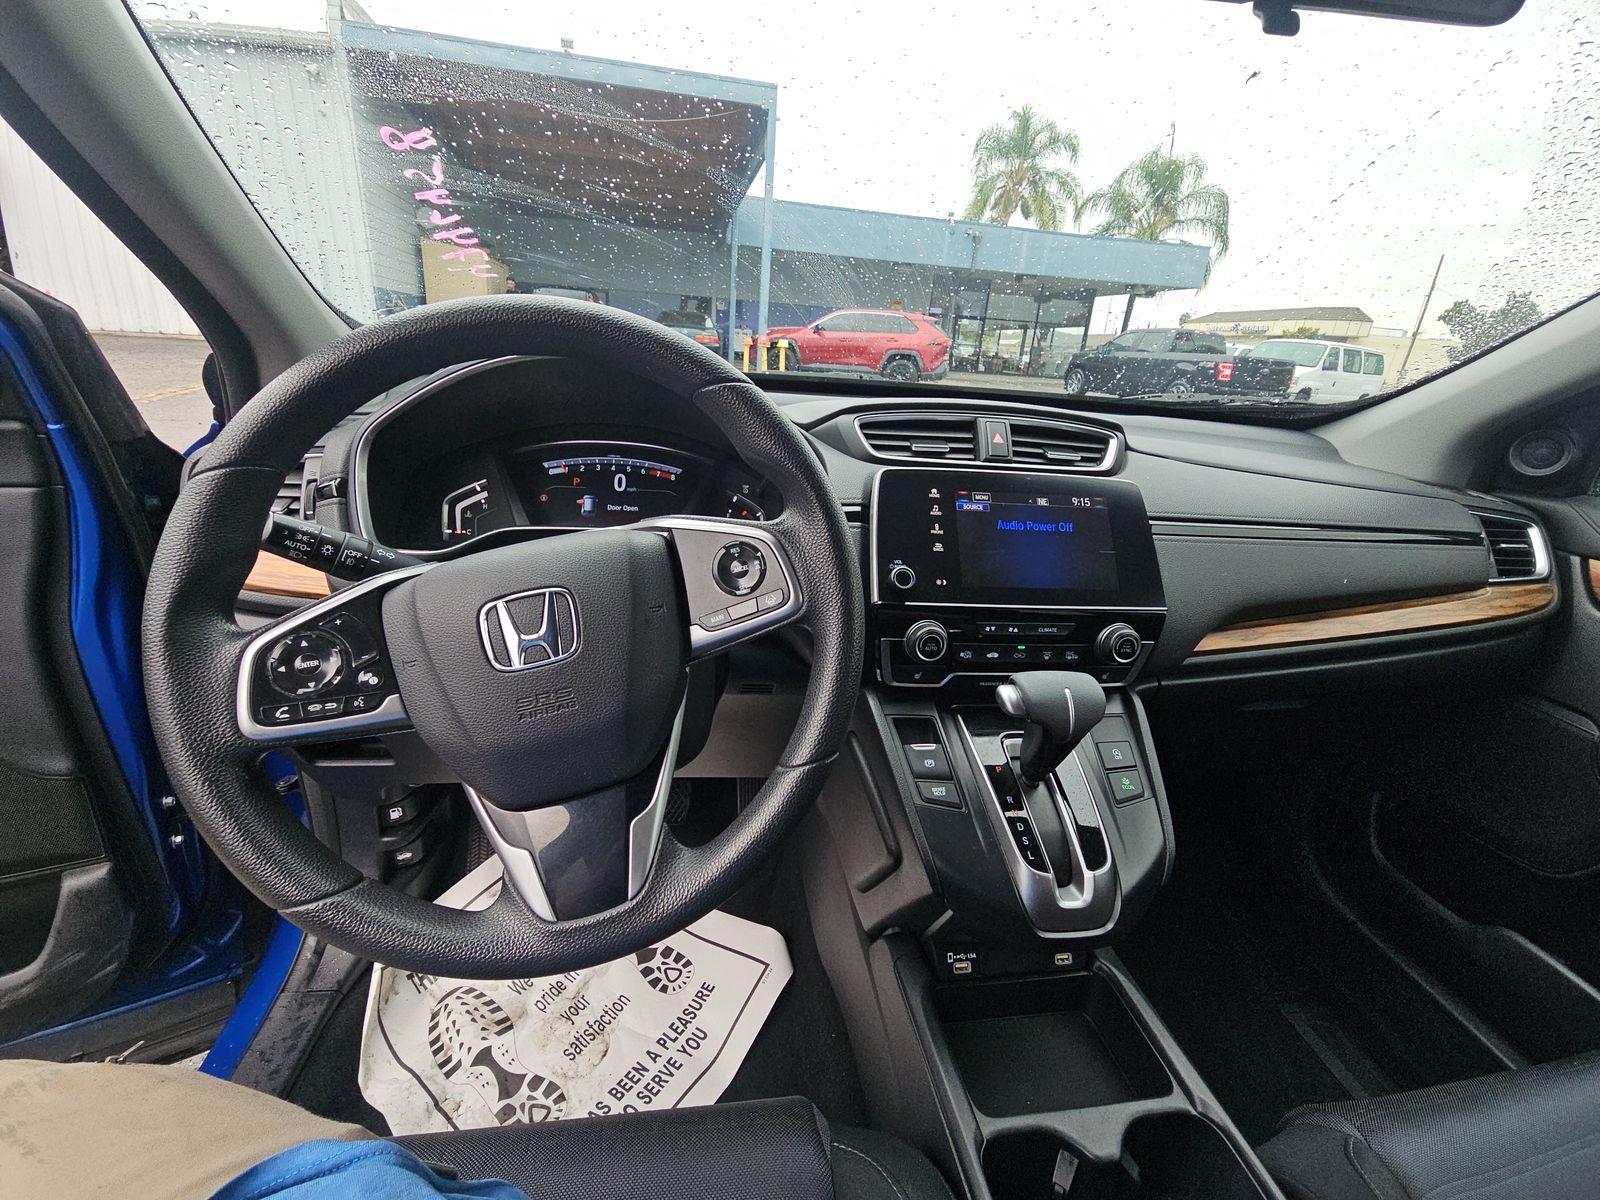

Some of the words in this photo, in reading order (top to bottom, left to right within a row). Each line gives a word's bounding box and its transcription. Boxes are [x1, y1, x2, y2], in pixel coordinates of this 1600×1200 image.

[574, 477, 580, 486] P
[614, 473, 626, 491] 0
[1071, 497, 1091, 506] 9:15
[299, 525, 314, 533] OFF
[997, 520, 1024, 530] Audio
[1026, 521, 1056, 531] Power
[1059, 522, 1073, 532] Off
[284, 540, 307, 551] AUTO
[348, 550, 362, 558] OFF
[710, 614, 725, 623] MAIN
[516, 687, 574, 709] SRS
[518, 702, 579, 723] AIRBAG
[1006, 796, 1014, 804] R
[1016, 823, 1024, 831] D
[1022, 837, 1029, 845] S
[1027, 851, 1035, 860] L
[506, 978, 534, 996] We
[533, 981, 568, 1013] pride
[560, 993, 591, 1026] your
[562, 993, 631, 1062] satisfaction
[587, 1101, 612, 1118] AS
[608, 1061, 650, 1102] BEEN
[646, 1050, 663, 1064] A
[656, 981, 716, 1050] PLEASURE
[636, 1056, 684, 1105] SERVE
[676, 1026, 708, 1058] YOU
